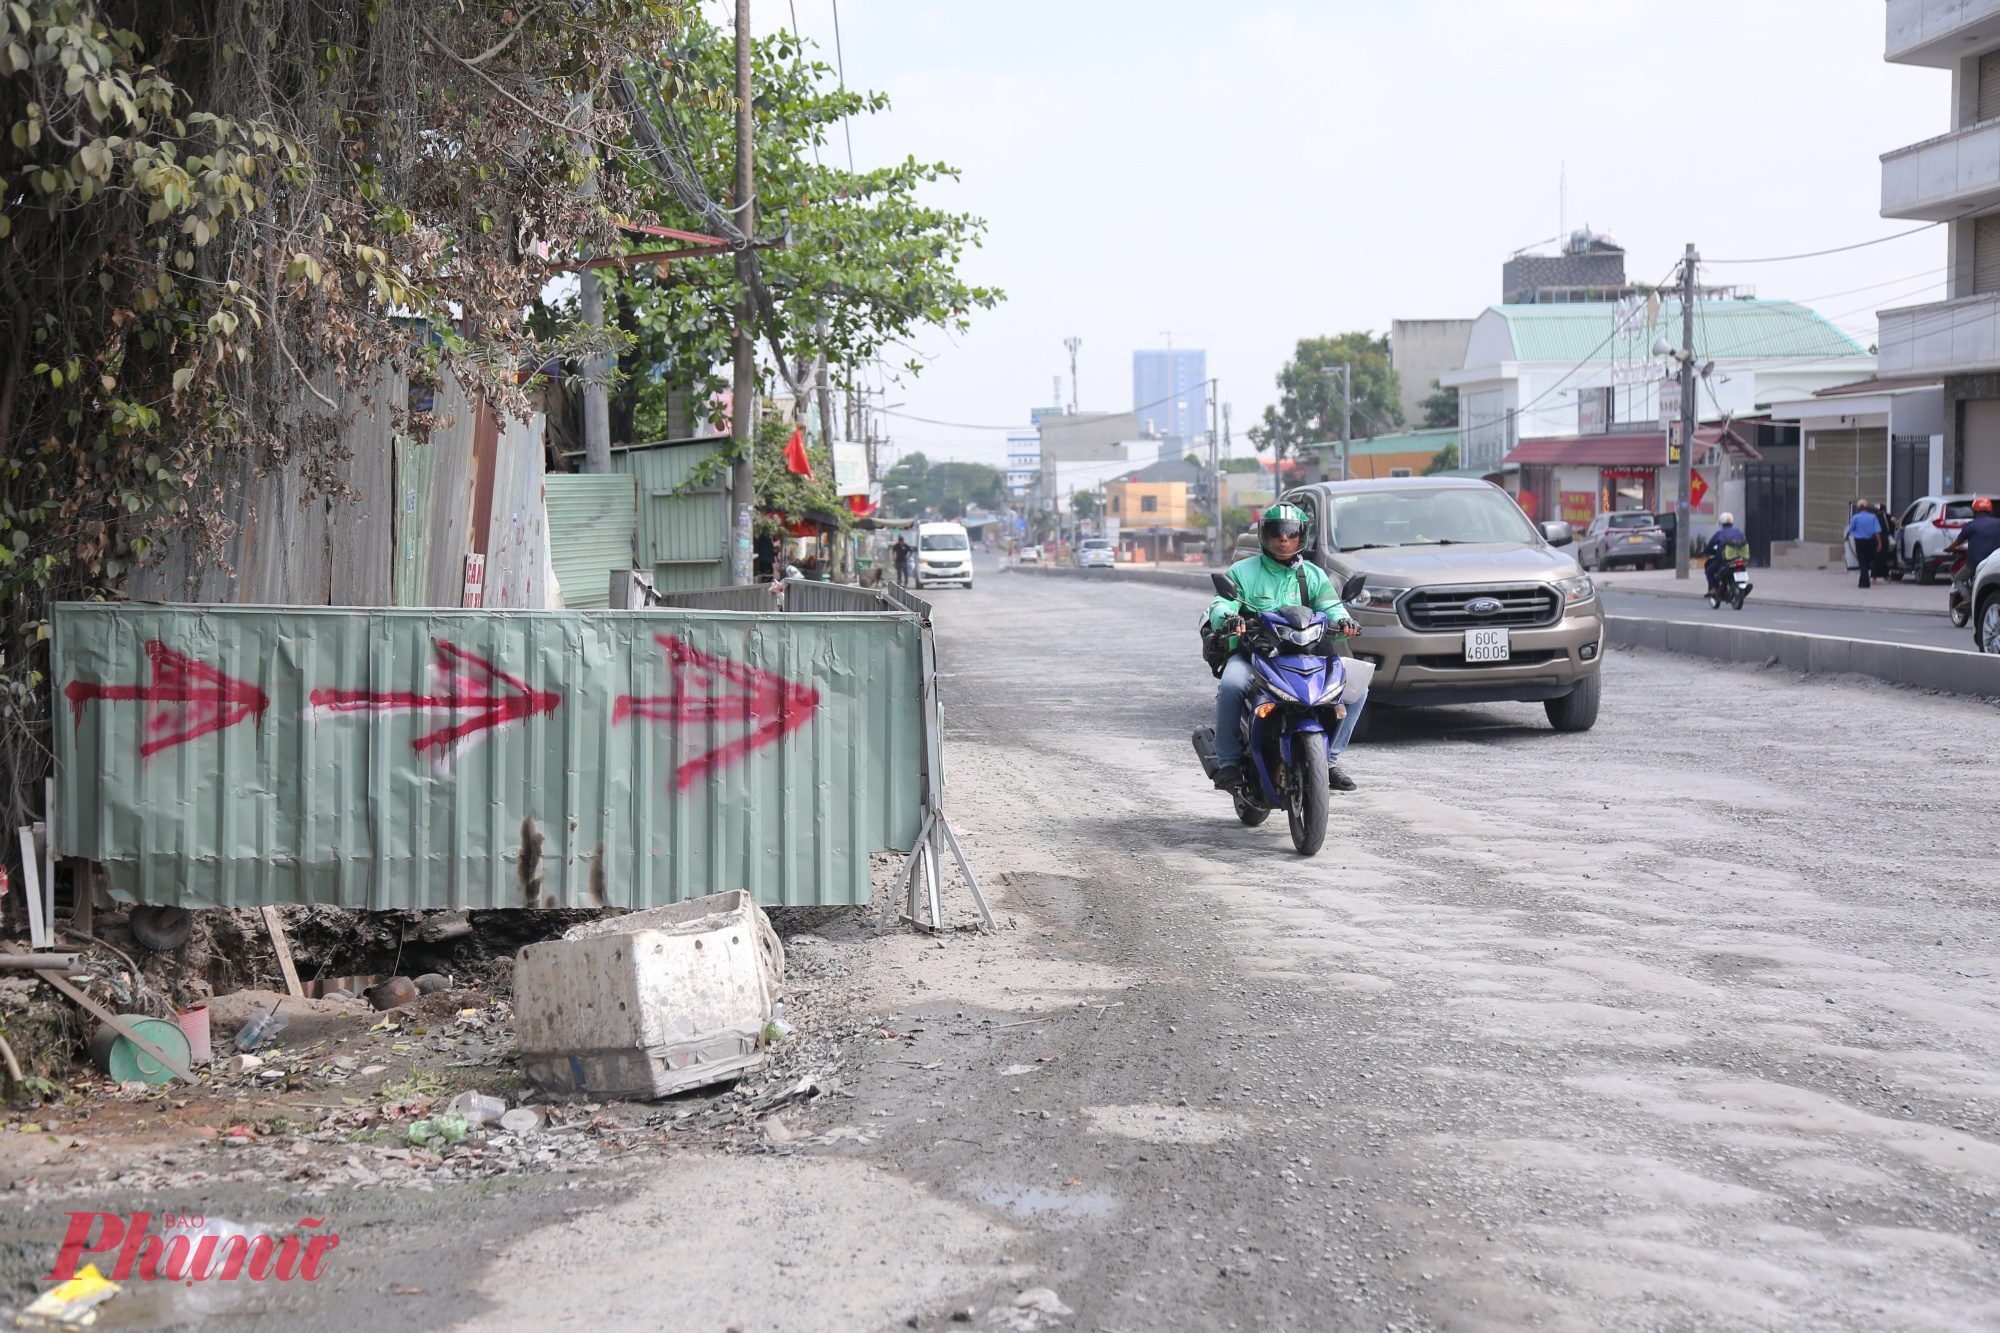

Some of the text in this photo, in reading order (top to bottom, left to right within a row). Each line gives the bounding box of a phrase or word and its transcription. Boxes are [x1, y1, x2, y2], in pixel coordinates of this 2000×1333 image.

[1474, 602, 1494, 612] Ford
[1475, 631, 1498, 645] 60C
[1467, 646, 1508, 661] 460.05
